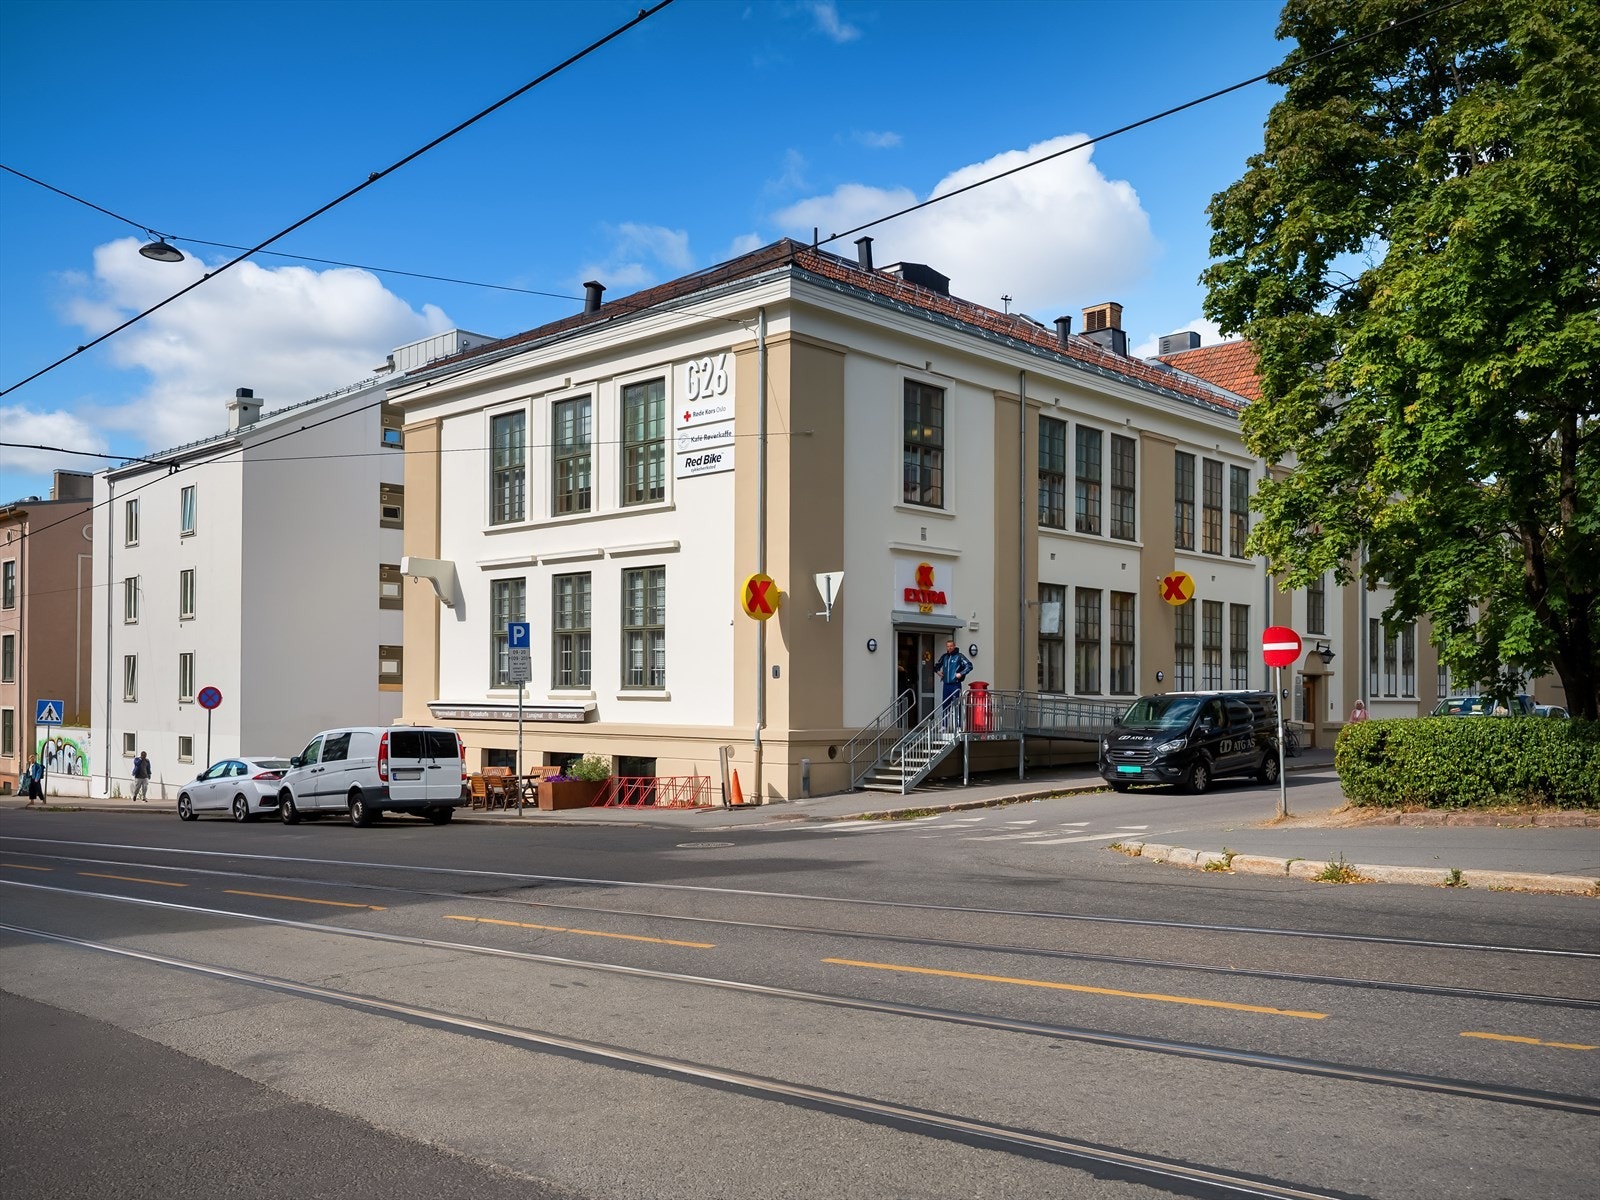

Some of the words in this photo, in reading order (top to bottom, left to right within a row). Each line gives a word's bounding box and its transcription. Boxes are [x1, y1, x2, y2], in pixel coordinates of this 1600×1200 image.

[685, 456, 703, 468] Red
[703, 453, 721, 465] Bike
[904, 588, 947, 605] EXTRA
[513, 625, 525, 645] P
[1234, 740, 1246, 751] ATG
[1247, 738, 1256, 748] AS
